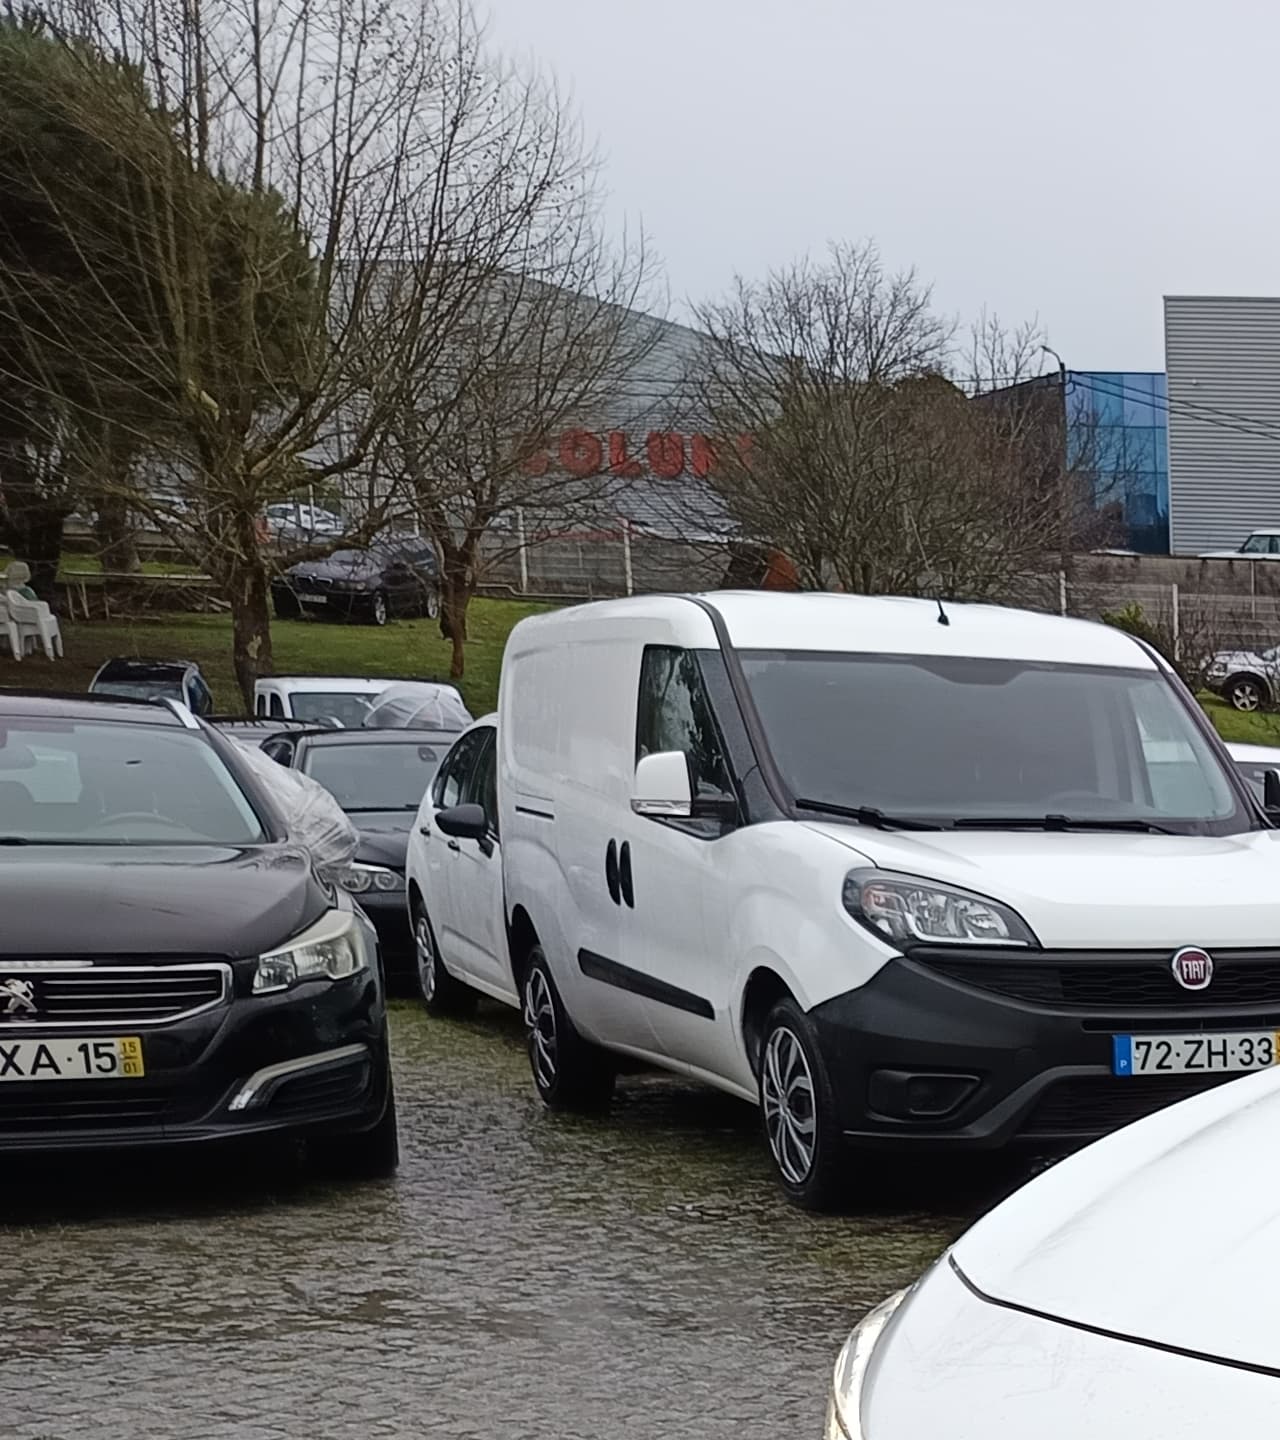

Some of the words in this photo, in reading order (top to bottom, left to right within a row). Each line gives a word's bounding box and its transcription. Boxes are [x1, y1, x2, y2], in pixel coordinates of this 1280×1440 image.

[1181, 960, 1205, 980] FIAT
[122, 1042, 137, 1054] 15
[123, 1062, 138, 1073] 01
[1120, 1060, 1128, 1069] P
